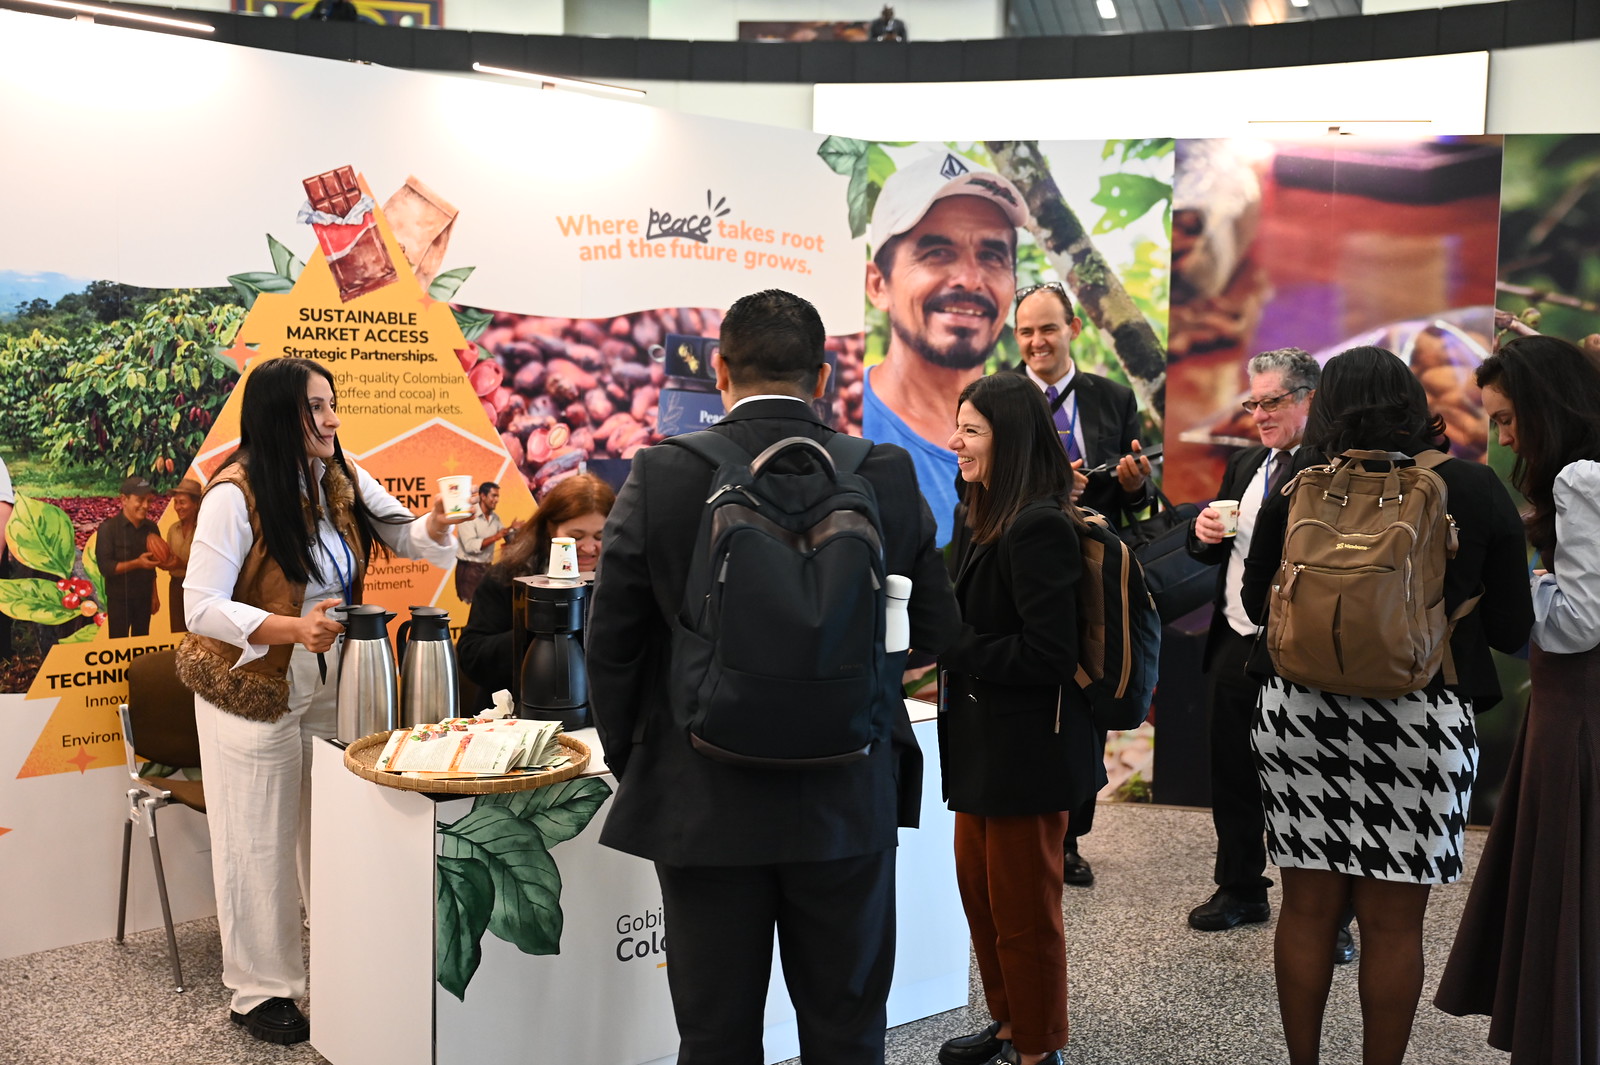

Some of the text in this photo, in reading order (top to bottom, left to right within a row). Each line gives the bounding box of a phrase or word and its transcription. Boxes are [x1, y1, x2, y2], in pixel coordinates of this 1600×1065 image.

[556, 207, 825, 253] Where peace takes root
[579, 237, 813, 275] and the future grows.
[299, 308, 417, 325] SUSTAINABLE
[286, 326, 429, 344] MARKET ACCESS
[282, 346, 438, 364] Strategic Partnerships.
[402, 372, 465, 385] Colombian
[374, 387, 397, 399] and
[399, 388, 437, 401] cocoa)
[439, 388, 450, 399] in
[336, 403, 463, 415] international markets.
[366, 561, 430, 577] Ownership
[616, 907, 661, 934] Gobi
